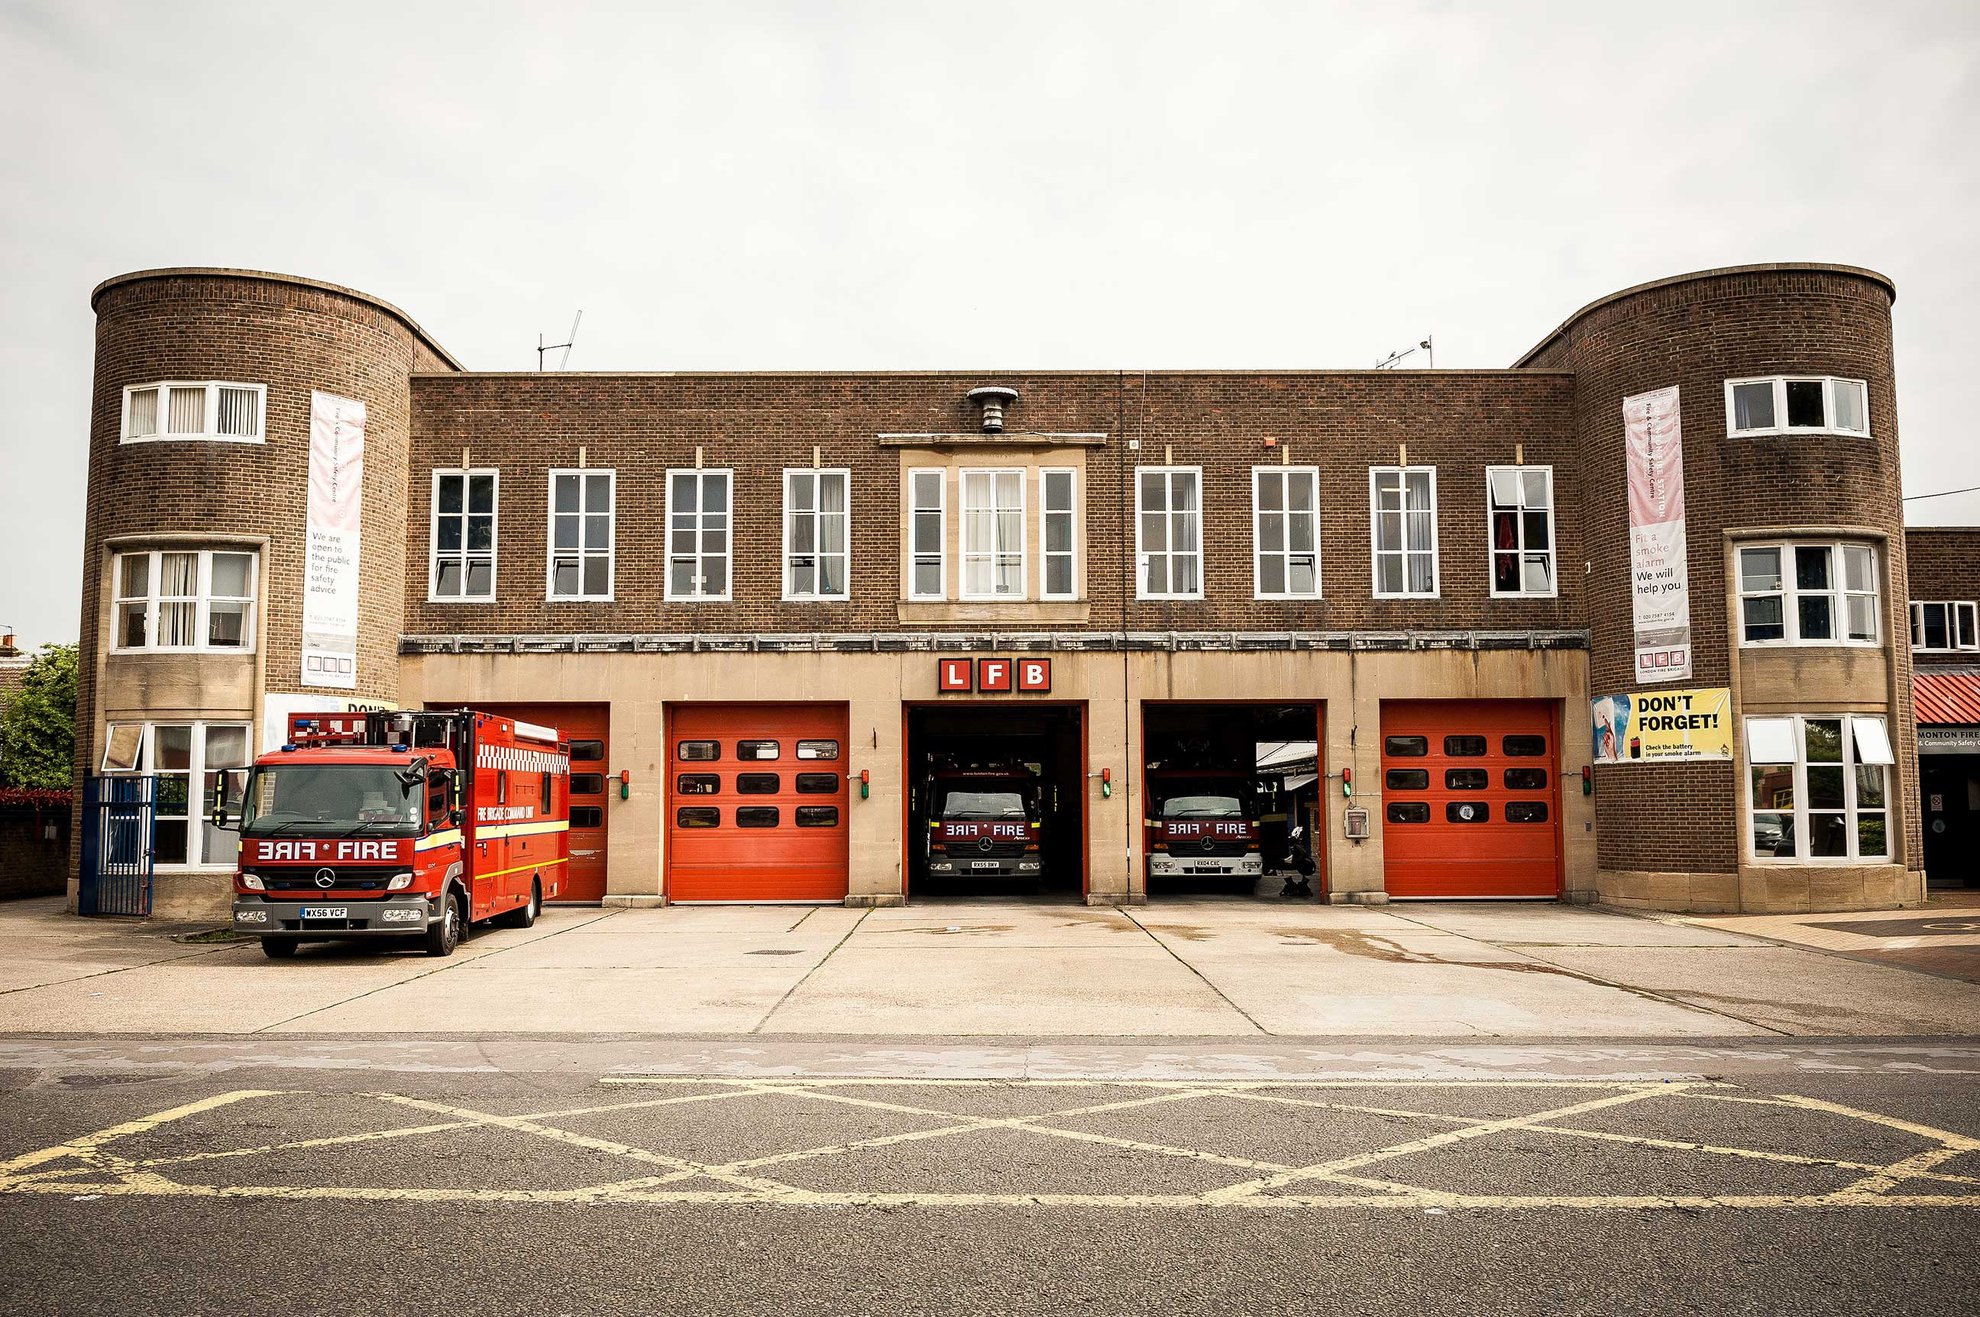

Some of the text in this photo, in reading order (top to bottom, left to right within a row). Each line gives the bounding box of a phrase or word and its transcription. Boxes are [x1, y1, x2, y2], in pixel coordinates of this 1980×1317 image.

[1656, 479, 1665, 518] STATION
[313, 532, 326, 541] We
[1636, 534, 1647, 543] Fit
[312, 544, 332, 552] open
[1636, 544, 1669, 556] smoke
[312, 553, 350, 565] the public
[1636, 558, 1664, 569] alarm
[312, 563, 338, 574] for fire
[1636, 568, 1673, 581] We will
[311, 574, 334, 586] safety
[310, 585, 336, 594] advice
[1637, 582, 1681, 595] help you
[948, 664, 1043, 684] L F B
[1638, 696, 1693, 712] DON'T
[1639, 714, 1718, 731] FORGET!
[478, 807, 486, 821] FIRE
[487, 807, 504, 820] BRIGADE
[526, 806, 534, 818] UNIT
[993, 825, 1024, 835] FIRE
[1216, 824, 1246, 834] FIRE
[338, 842, 397, 859] FIRE
[306, 908, 345, 917] WX56 VCF
